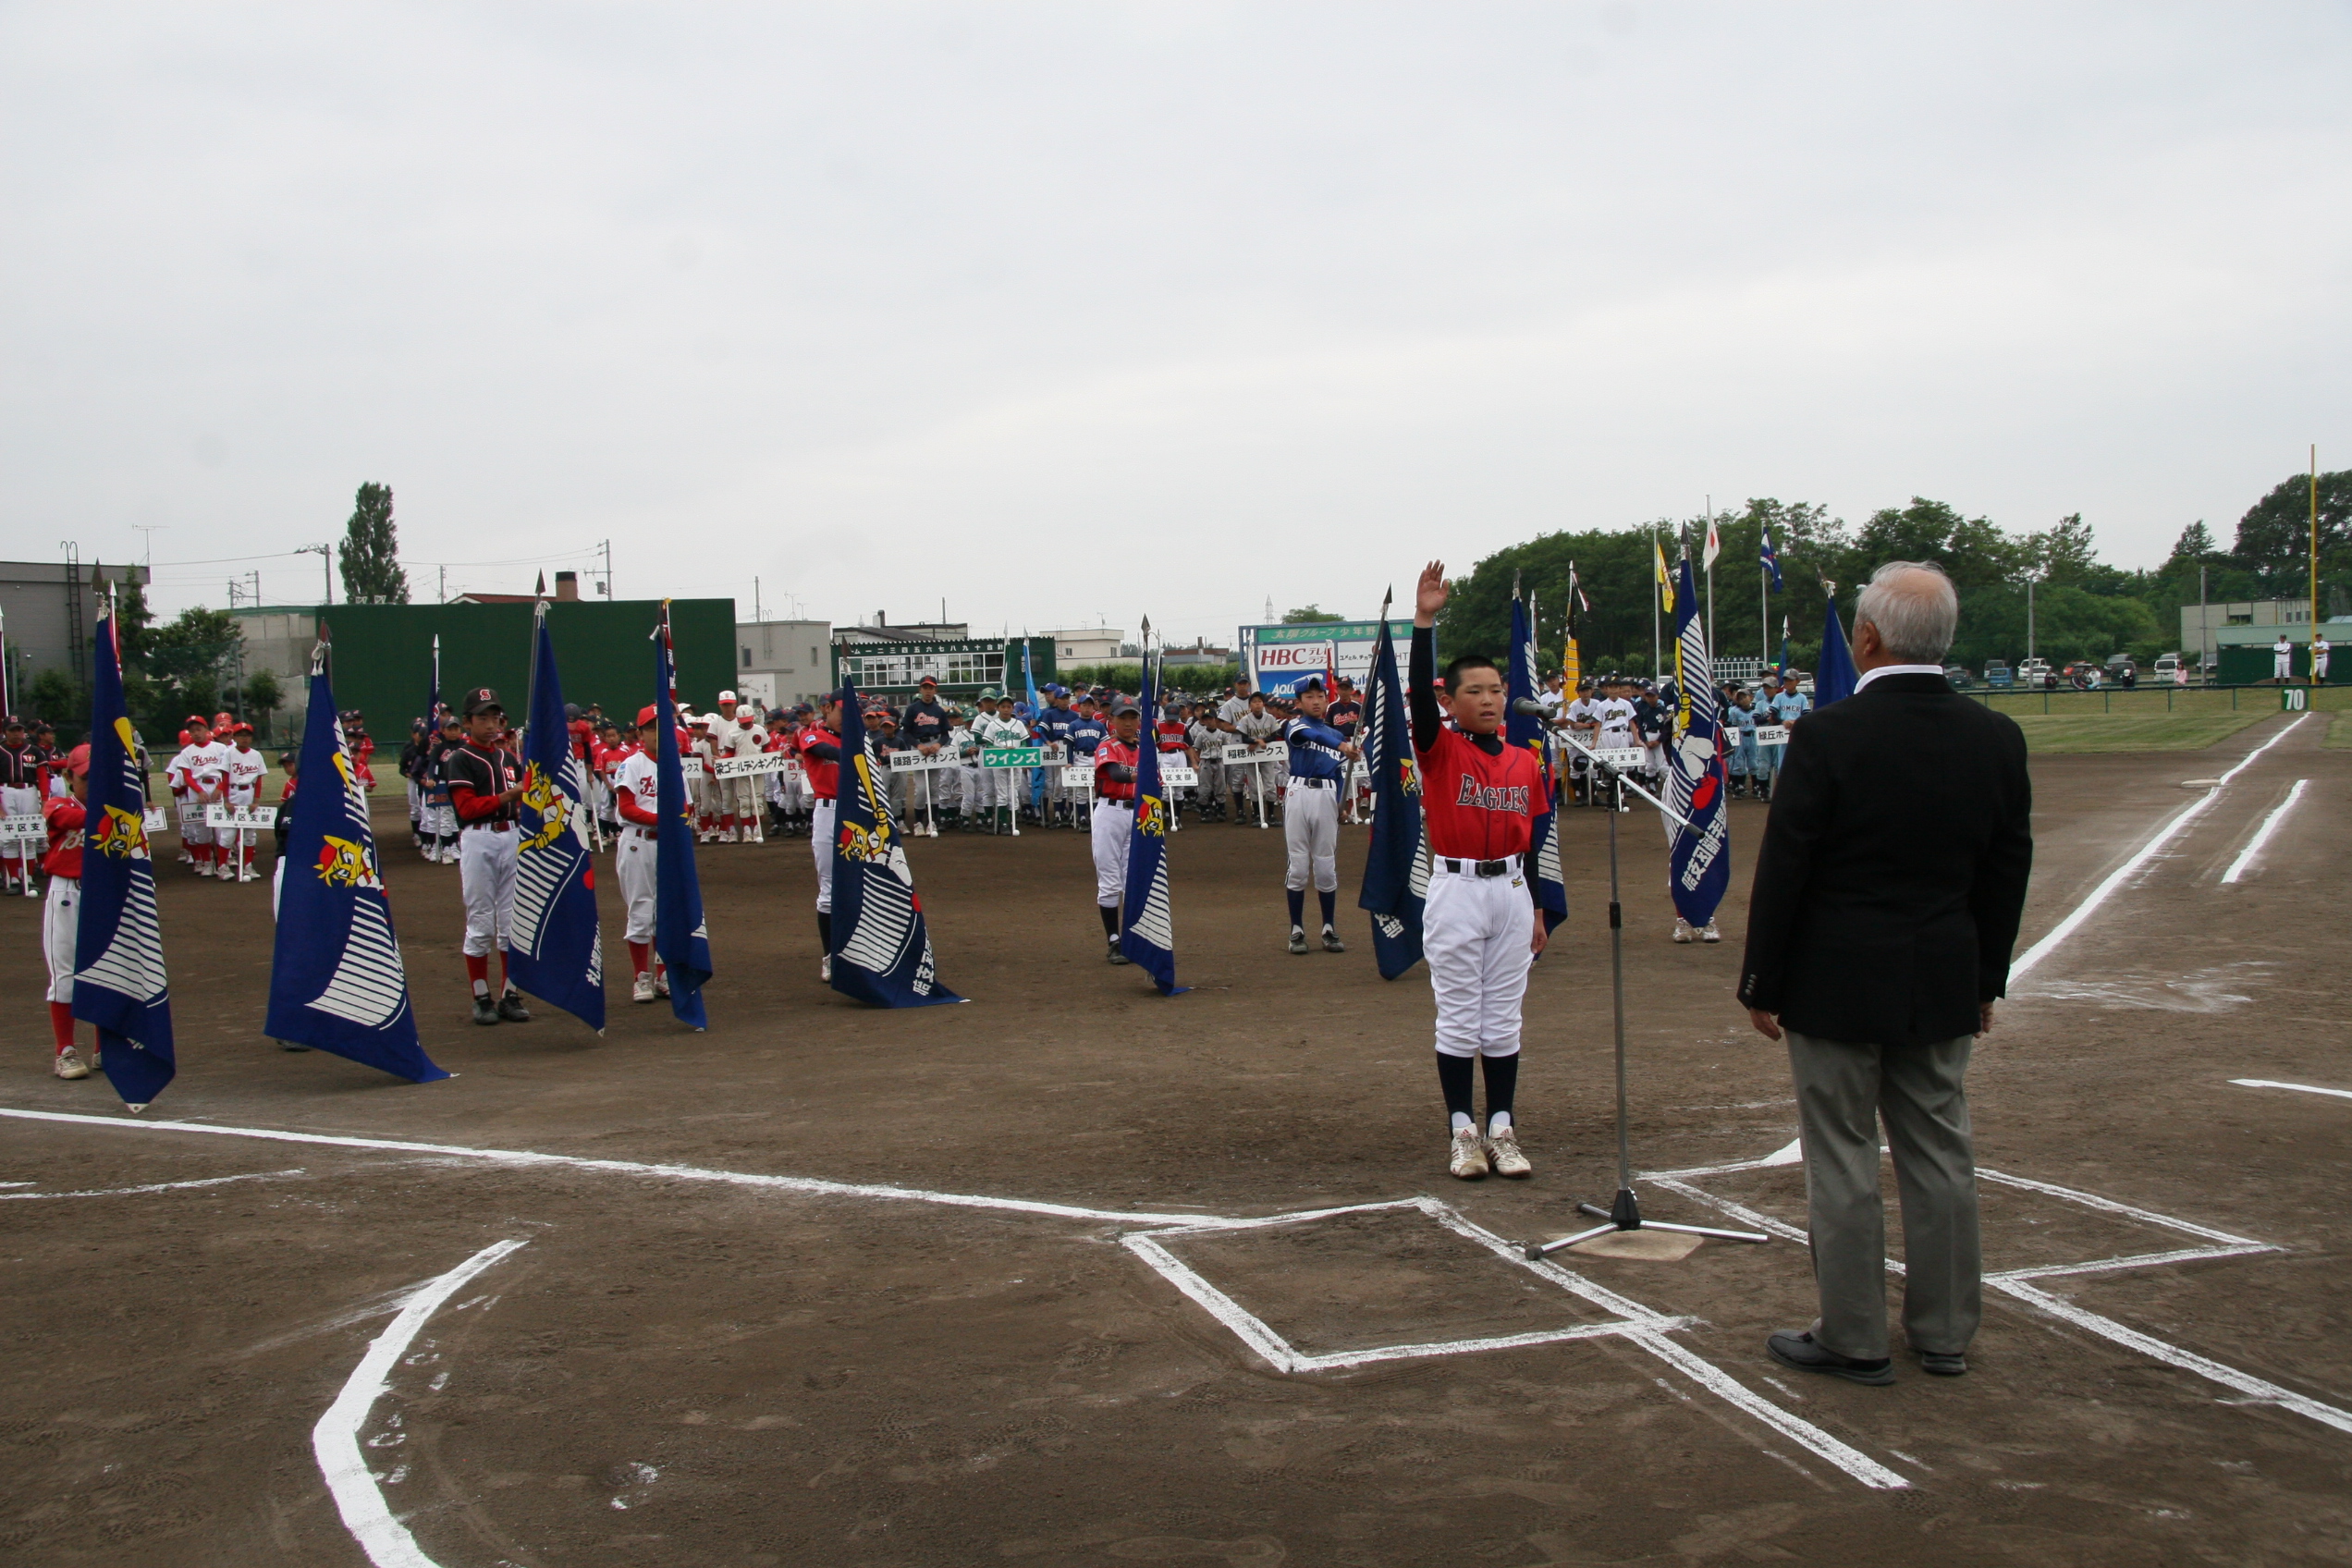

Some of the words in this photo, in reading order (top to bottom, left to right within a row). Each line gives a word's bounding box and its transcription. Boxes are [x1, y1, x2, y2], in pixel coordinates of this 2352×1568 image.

[1341, 625, 1403, 637] 少年野場
[1260, 647, 1308, 666] HBC
[480, 689, 491, 701] S
[2284, 689, 2304, 710] 70
[985, 752, 1037, 766] ウインズ
[1456, 773, 1530, 817] EAGLES
[3, 822, 42, 833] 平区支
